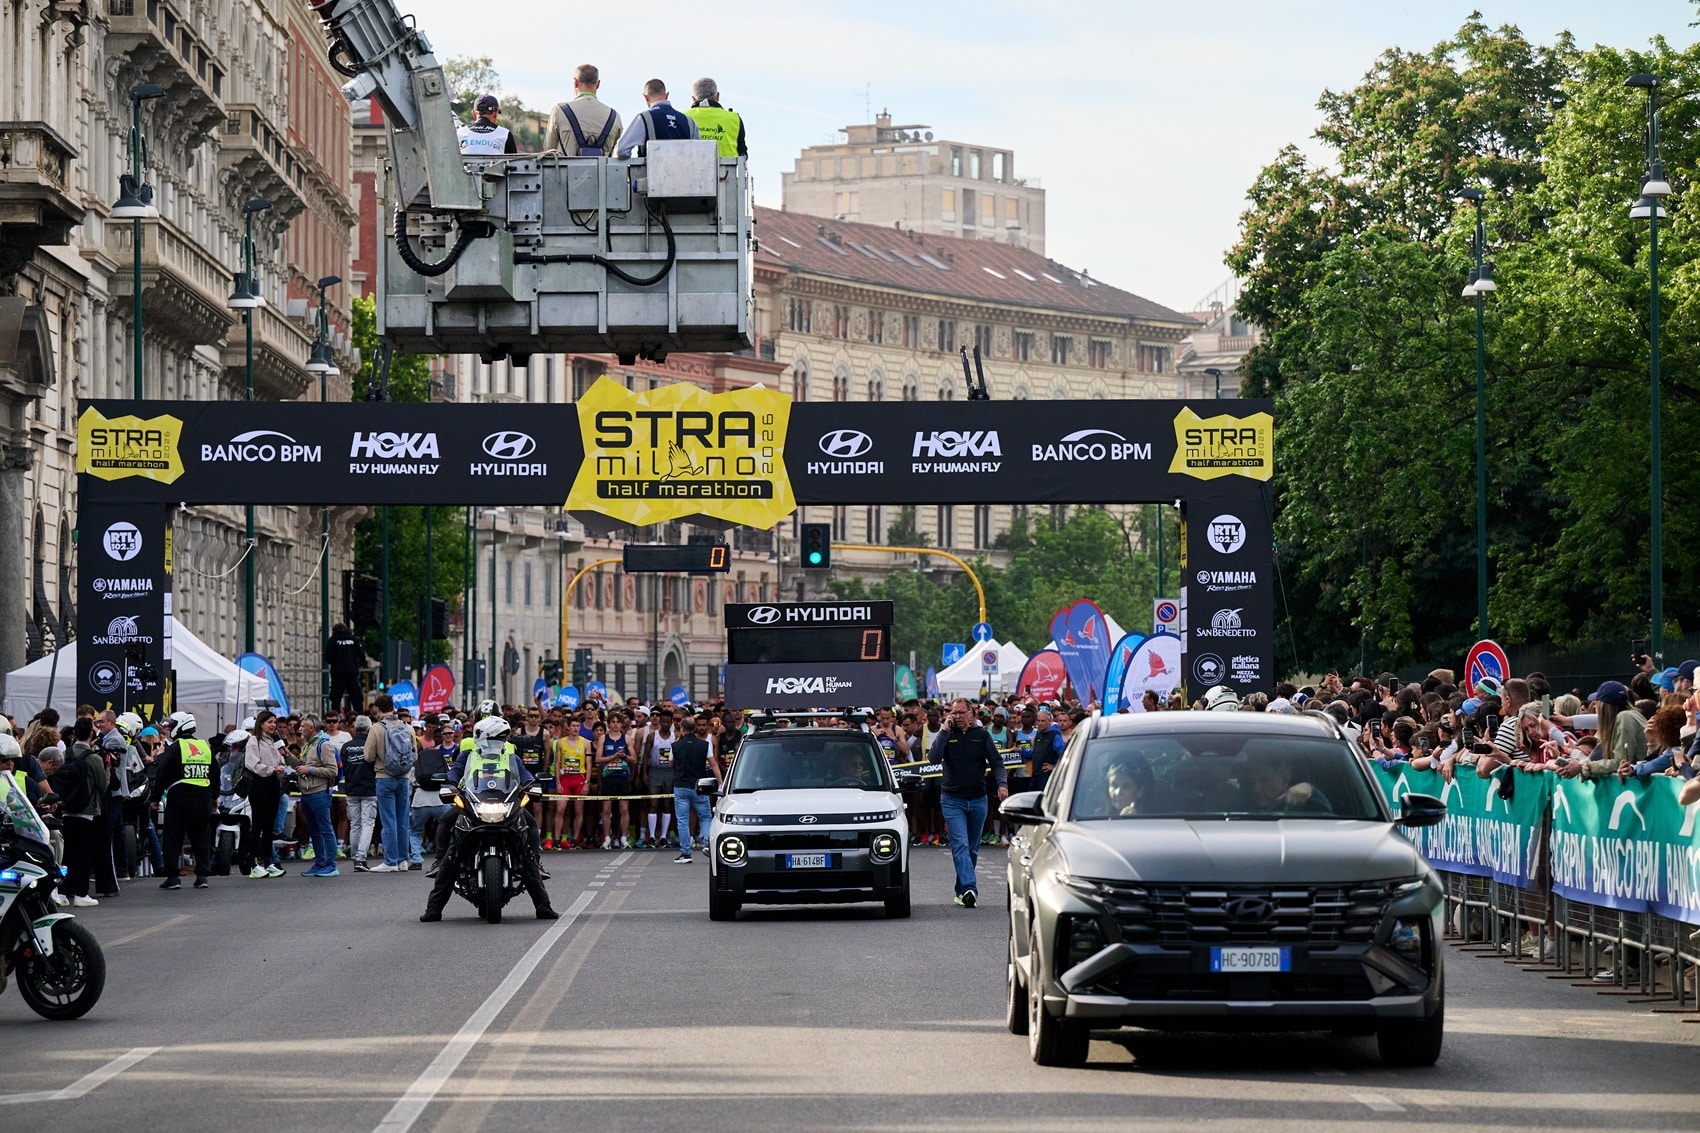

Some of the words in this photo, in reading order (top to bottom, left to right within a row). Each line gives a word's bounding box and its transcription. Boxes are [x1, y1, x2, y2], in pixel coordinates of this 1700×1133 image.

[595, 411, 755, 448] STRA
[1185, 428, 1256, 446] STRA
[91, 429, 162, 447] STRA
[350, 432, 440, 458] HOKA
[762, 413, 773, 473] 2026
[912, 431, 1002, 457] HOKA
[201, 444, 276, 462] BANCO
[281, 445, 322, 462] BPM
[1032, 443, 1106, 461] BANCO
[1111, 443, 1152, 460] BPM
[96, 459, 115, 467] half
[118, 460, 165, 468] marathon
[350, 463, 369, 474] FLY
[371, 463, 417, 474] HUMAN
[419, 464, 439, 474] FLY
[470, 463, 547, 476] HYUNDAI
[807, 461, 884, 474] HYUNDAI
[912, 463, 932, 473] FLY
[933, 462, 979, 473] HUMAN
[981, 462, 1000, 472] FLY
[608, 482, 649, 496] half
[658, 482, 762, 496] marathon
[110, 532, 135, 543] RTL
[1214, 525, 1239, 535] RTL
[710, 547, 726, 568] 0
[107, 578, 153, 591] YAMAHA
[1210, 571, 1257, 584] YAMAHA
[786, 606, 871, 622] HYUNDAI
[861, 629, 883, 660] 0
[1231, 655, 1260, 663] atletica
[1231, 662, 1260, 670] italiana
[766, 677, 825, 694] HOKA
[184, 765, 209, 778] STAFF
[919, 764, 943, 773] HOKA
[1428, 814, 1457, 862] BANCO
[1457, 816, 1475, 865] BPM
[1476, 817, 1500, 872] BANCO
[1502, 822, 1521, 876] BPM
[1563, 832, 1586, 890] BPM
[1592, 836, 1634, 899] BANCO
[1636, 840, 1660, 902] BPM
